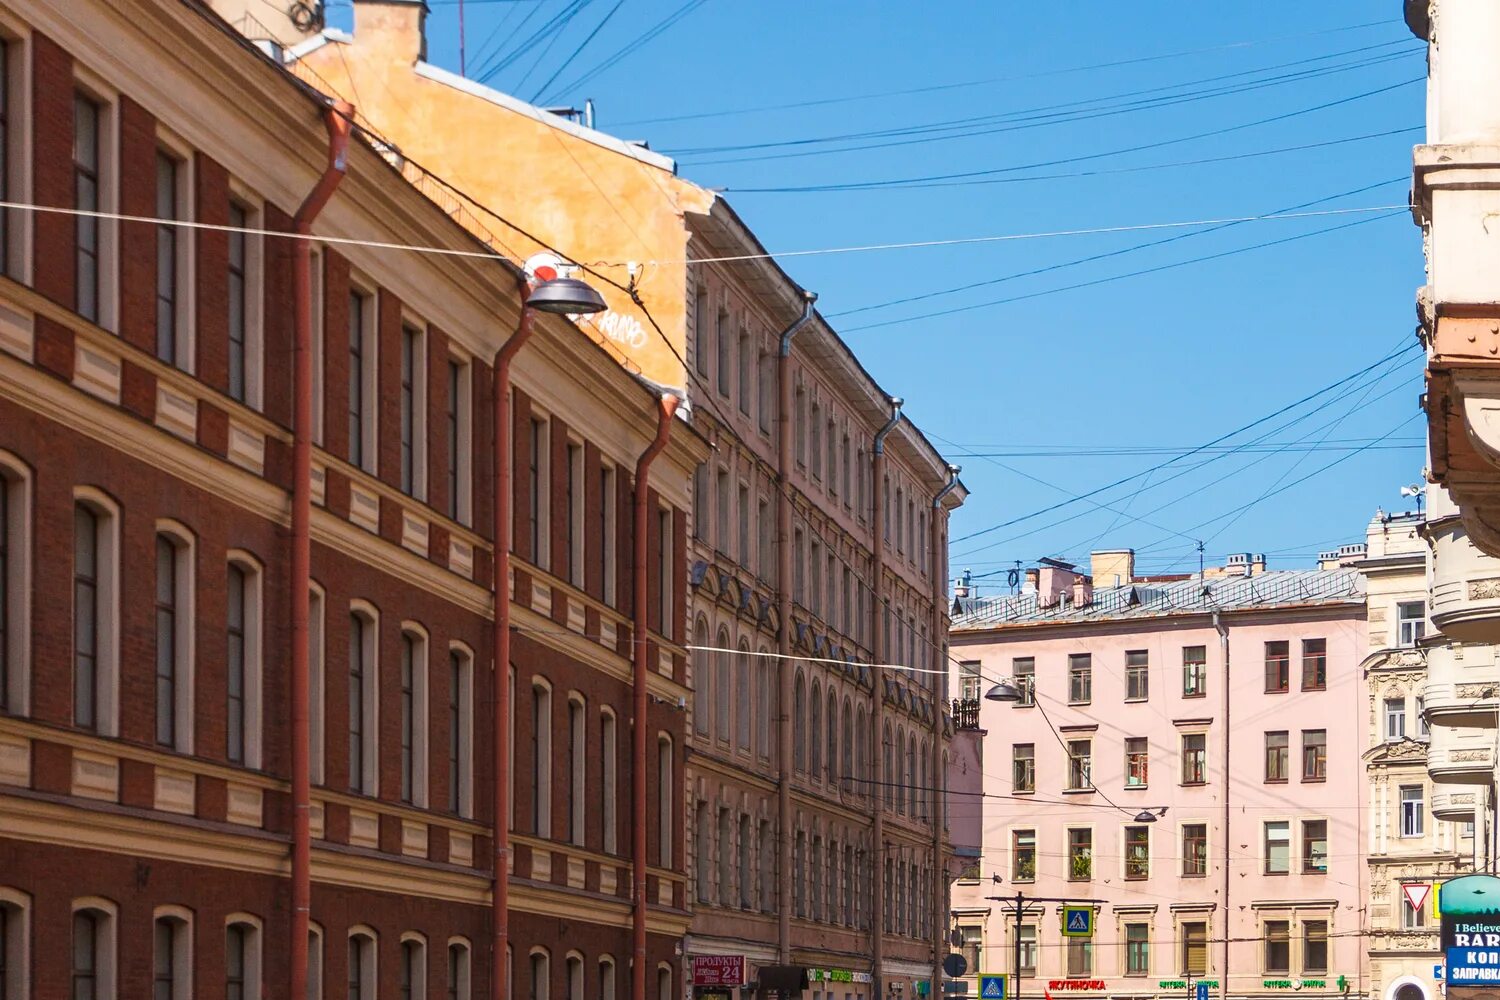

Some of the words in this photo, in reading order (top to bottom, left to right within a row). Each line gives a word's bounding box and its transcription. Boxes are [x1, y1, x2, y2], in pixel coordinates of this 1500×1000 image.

[1455, 924, 1460, 932] I
[1455, 934, 1500, 946] BAR
[696, 957, 741, 966] ПРОДУКТЫ
[722, 966, 739, 978] 24
